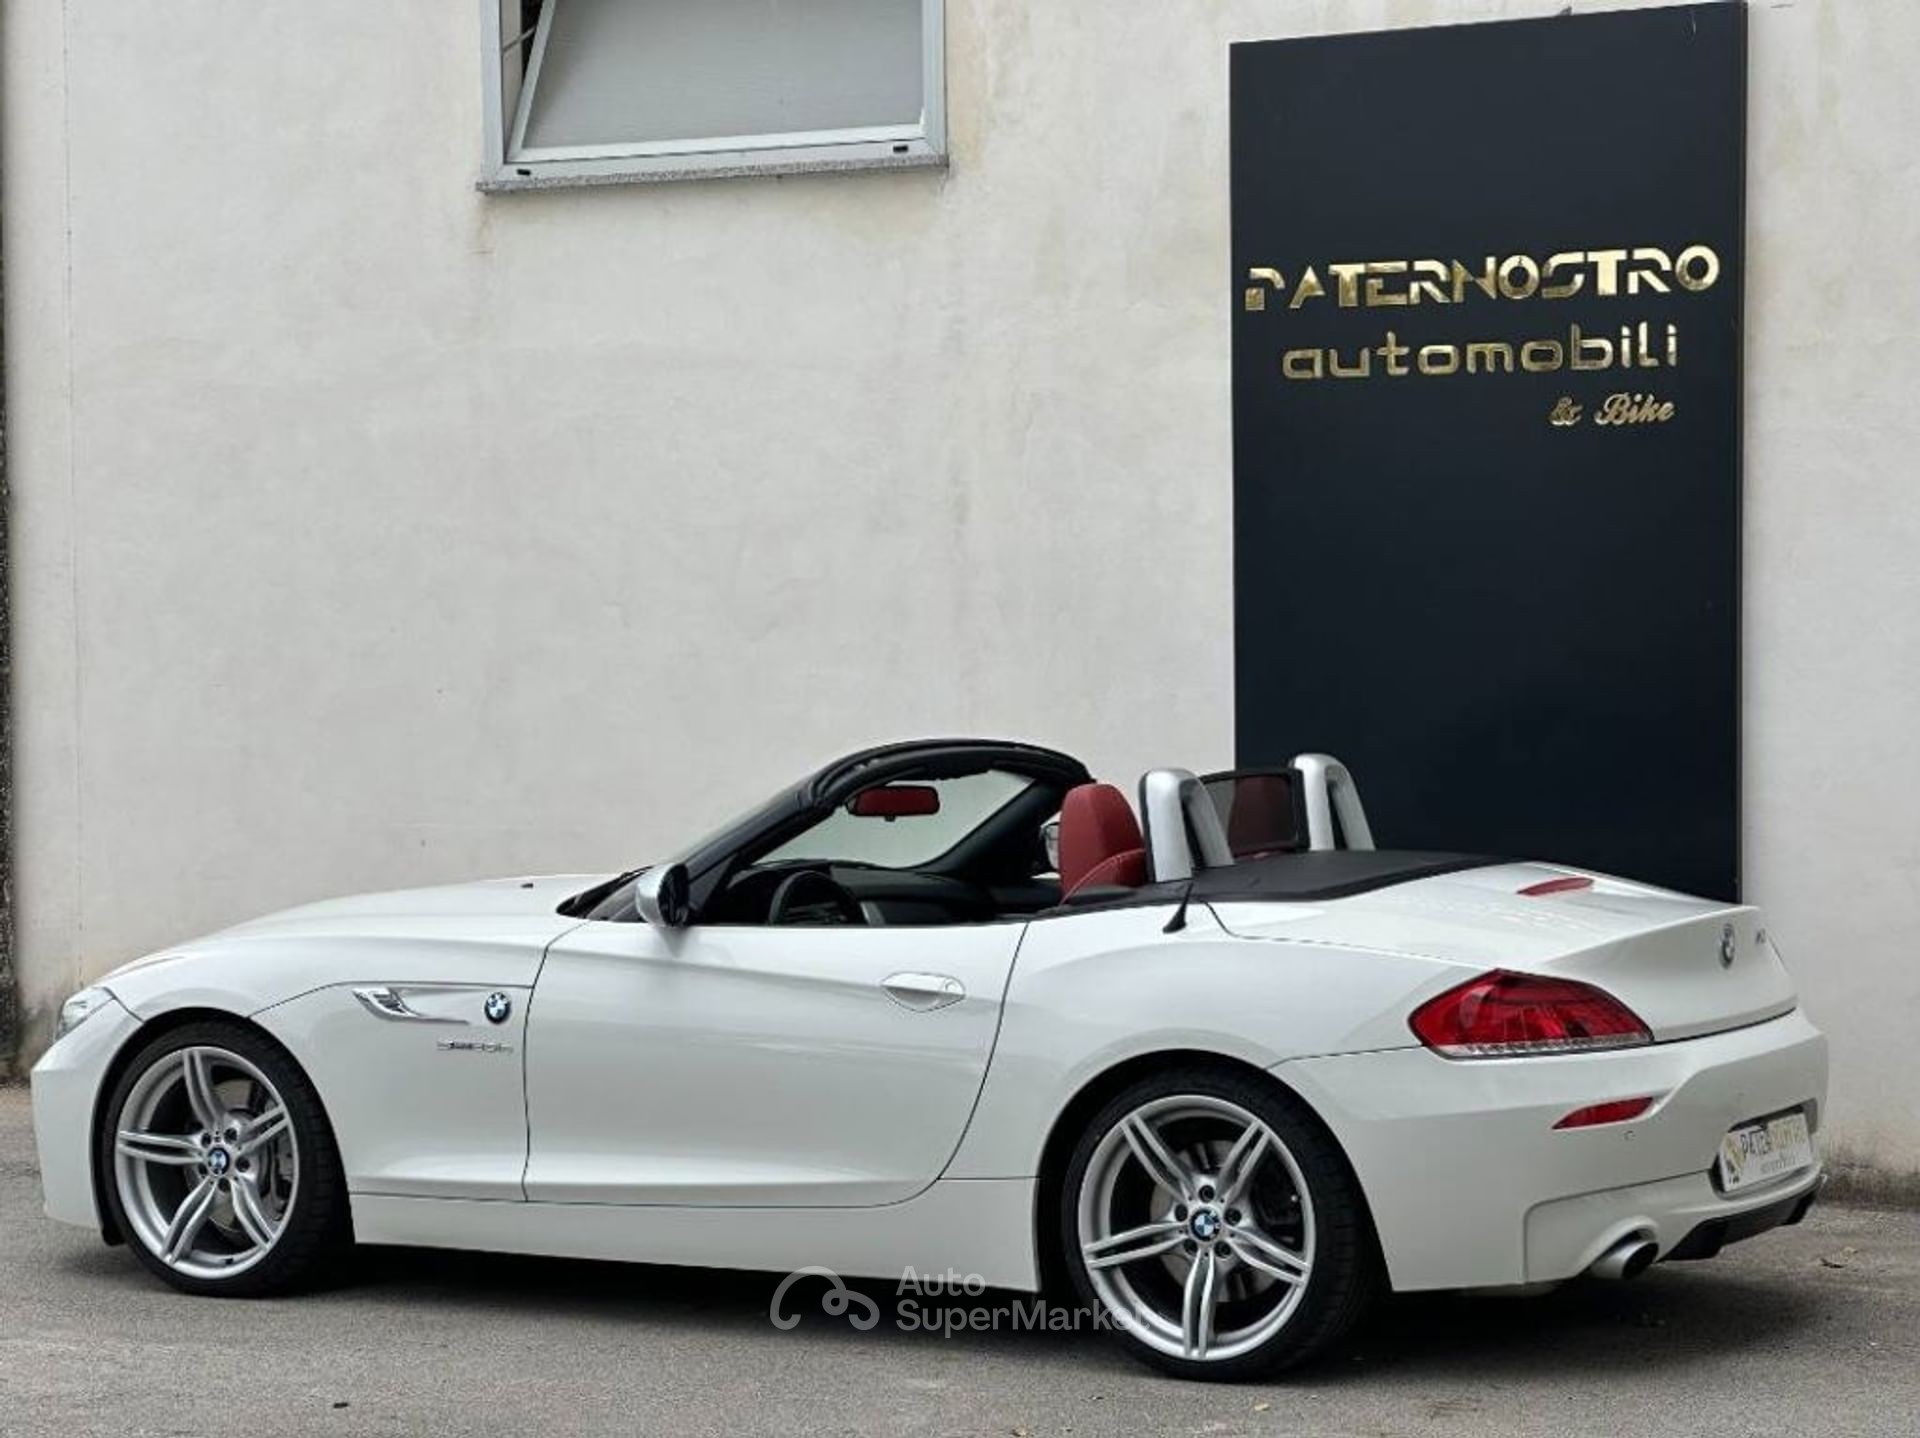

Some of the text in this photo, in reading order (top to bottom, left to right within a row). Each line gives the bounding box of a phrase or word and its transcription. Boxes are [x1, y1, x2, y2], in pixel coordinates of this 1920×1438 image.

[1245, 245, 1720, 310] PATERNOSTRO
[1282, 322, 1678, 379] automobili
[1549, 393, 1676, 426] & Bike
